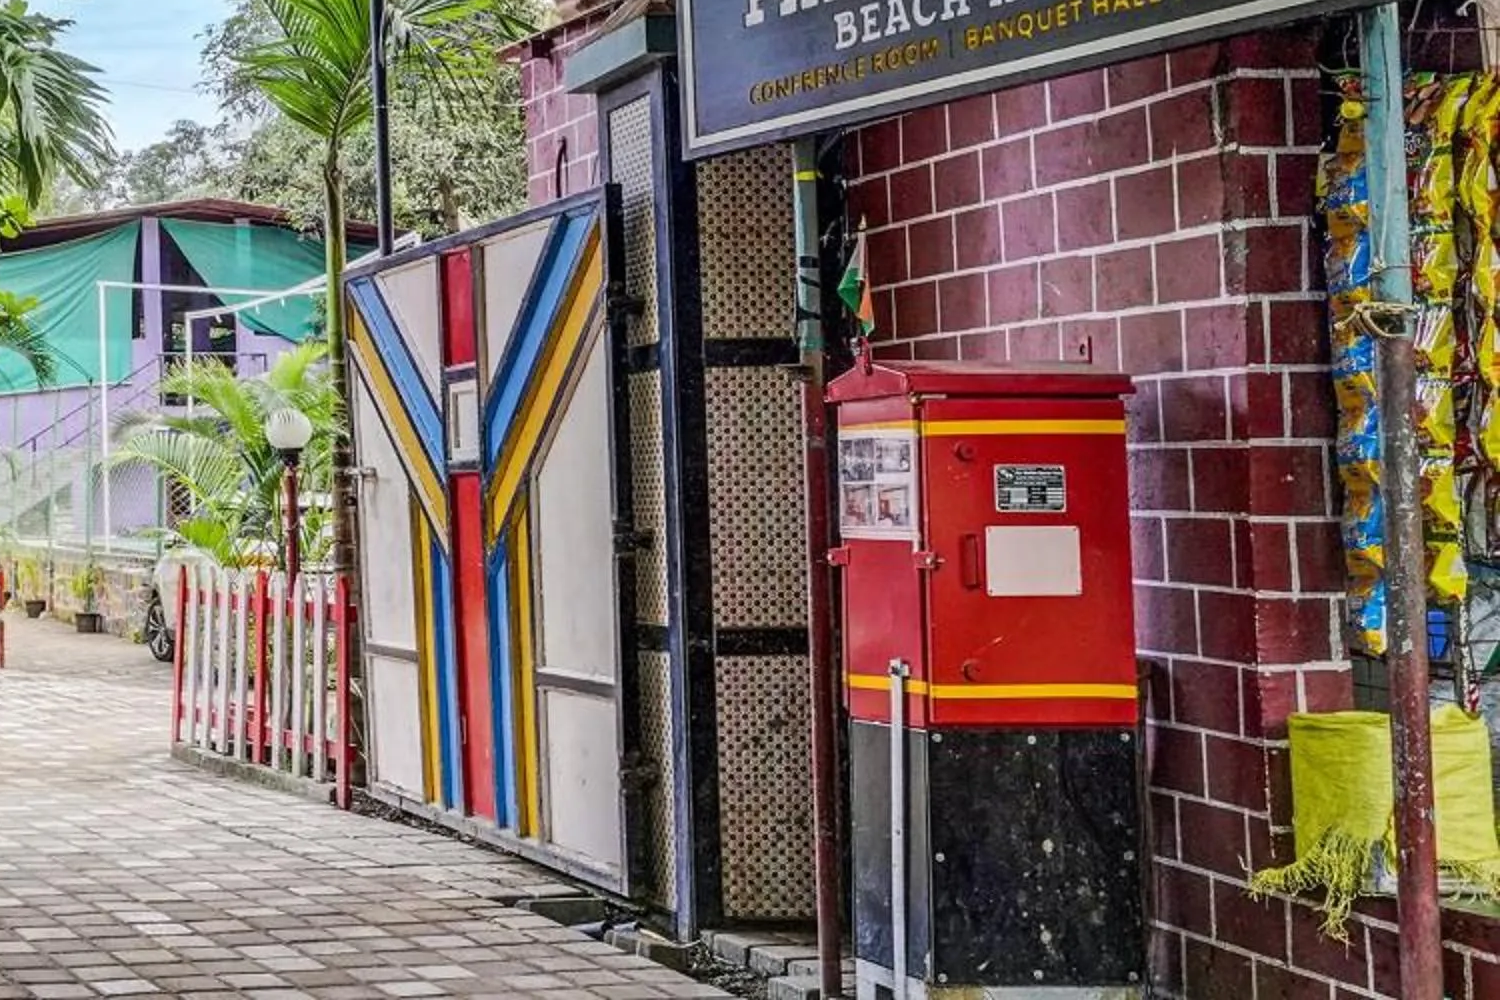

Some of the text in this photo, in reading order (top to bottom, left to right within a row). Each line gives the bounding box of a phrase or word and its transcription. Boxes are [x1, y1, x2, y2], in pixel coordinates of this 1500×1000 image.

[750, 55, 866, 105] CONFRENCE
[871, 39, 939, 74] ROOM
[964, 0, 1084, 50] BANQUET
